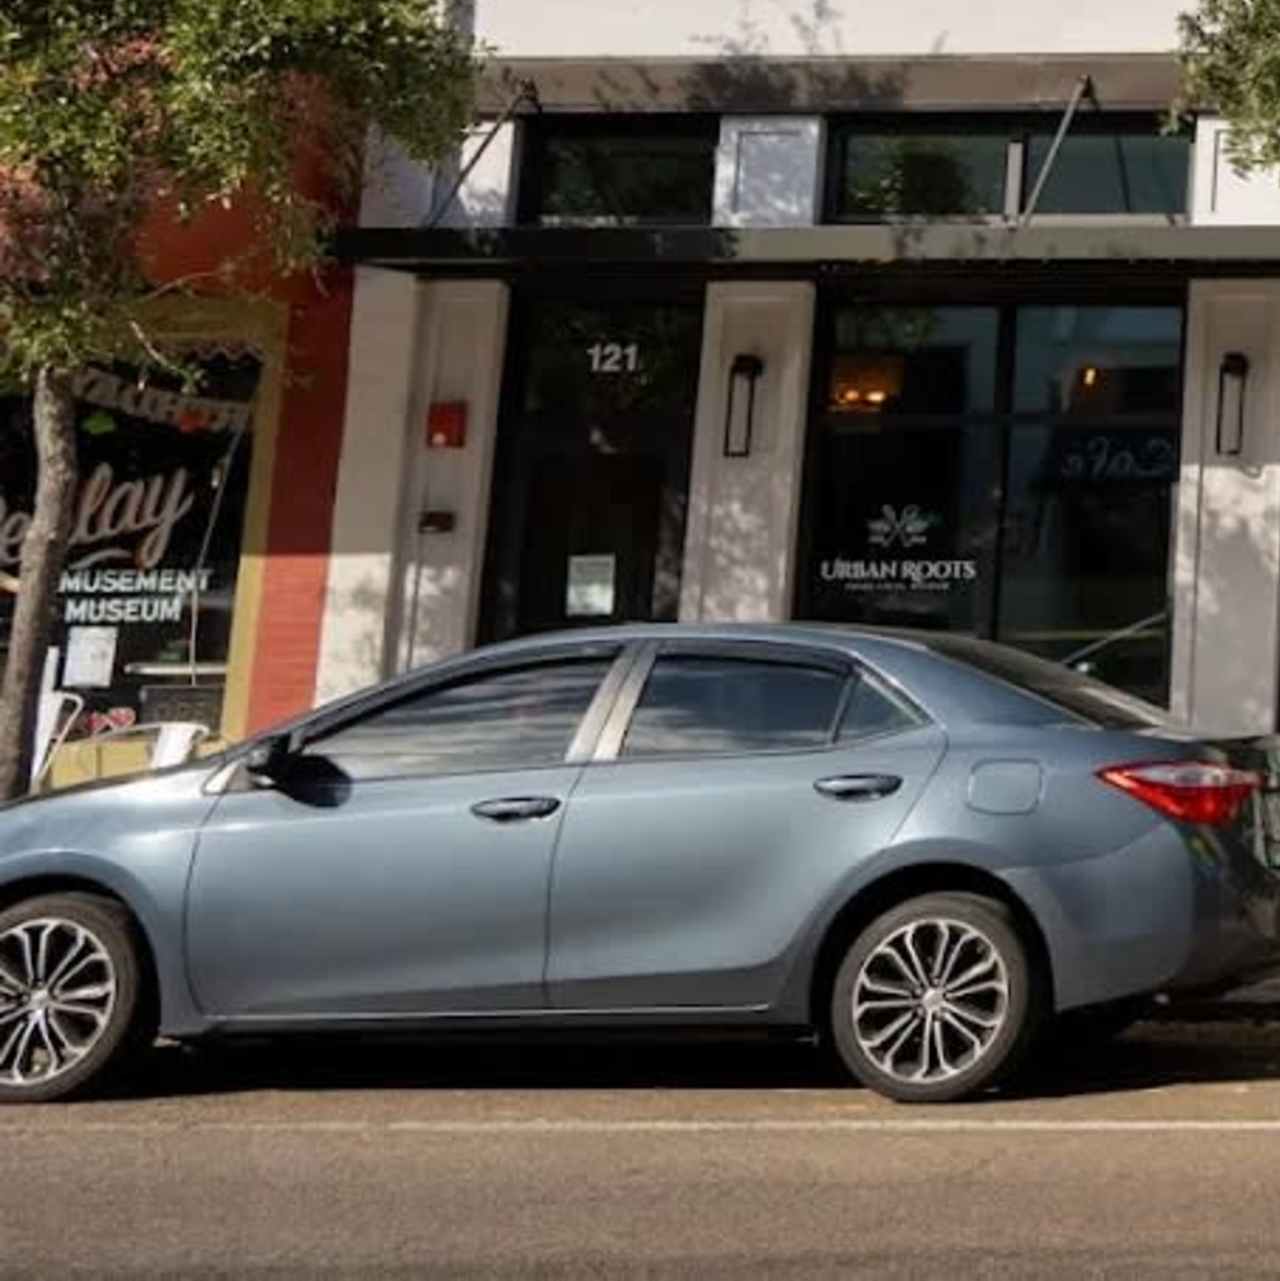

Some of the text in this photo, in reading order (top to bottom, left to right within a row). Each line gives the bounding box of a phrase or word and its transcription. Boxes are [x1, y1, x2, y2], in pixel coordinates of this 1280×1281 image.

[586, 344, 637, 372] 121
[58, 570, 210, 593] MUSEMENT
[820, 554, 978, 583] URBAN ROOTS
[64, 597, 183, 622] MUSEUM
